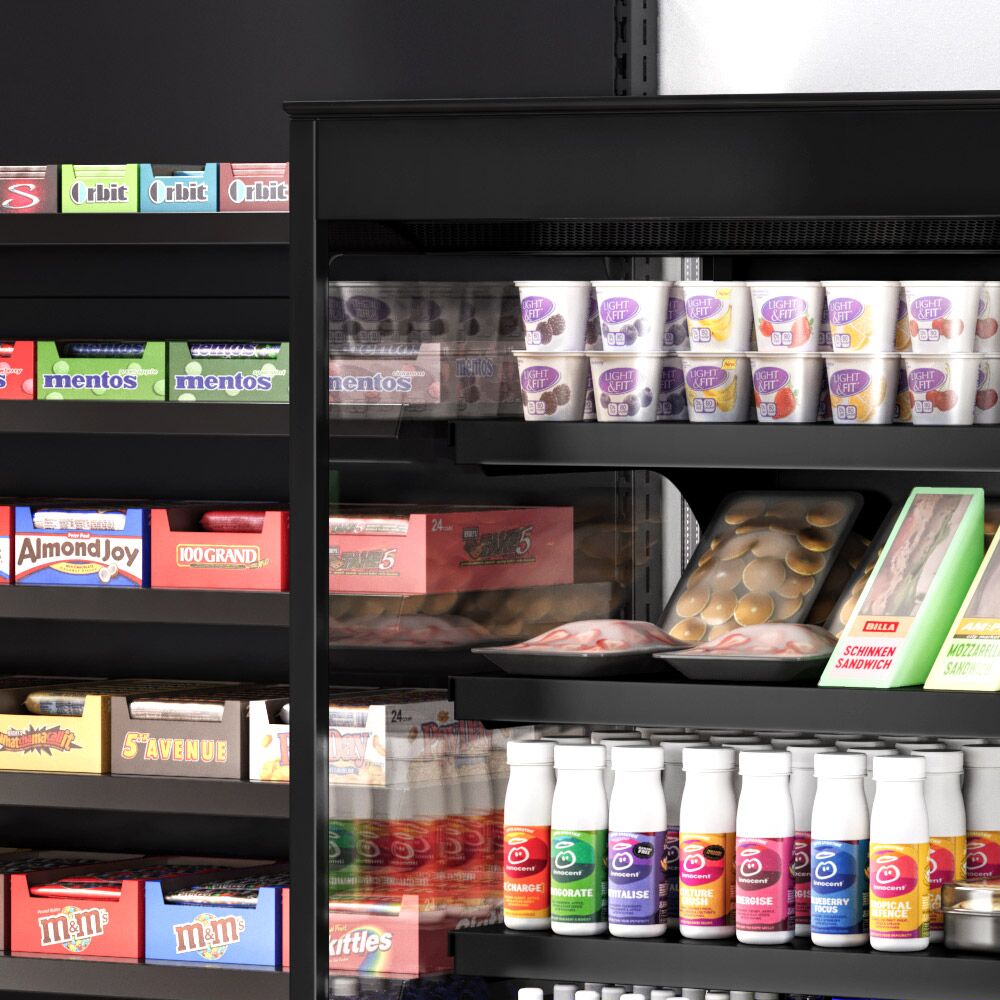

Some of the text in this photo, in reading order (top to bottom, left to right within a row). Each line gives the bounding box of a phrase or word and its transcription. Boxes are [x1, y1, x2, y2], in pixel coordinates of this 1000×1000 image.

[70, 180, 128, 204] Orbit
[149, 180, 208, 204] Orbit
[228, 179, 289, 203] Orbit
[43, 370, 138, 390] mentos
[175, 371, 272, 391] mentos
[431, 519, 443, 531] 24
[18, 538, 139, 567] Almond Joy
[180, 547, 257, 563] 100 GRAND
[865, 622, 896, 632] BILLA
[843, 645, 897, 657] SCHINKEN
[835, 659, 892, 670] SANDWICH
[145, 738, 227, 763] AVENUE
[815, 905, 838, 914] FOCUS
[329, 930, 393, 957] kittles
